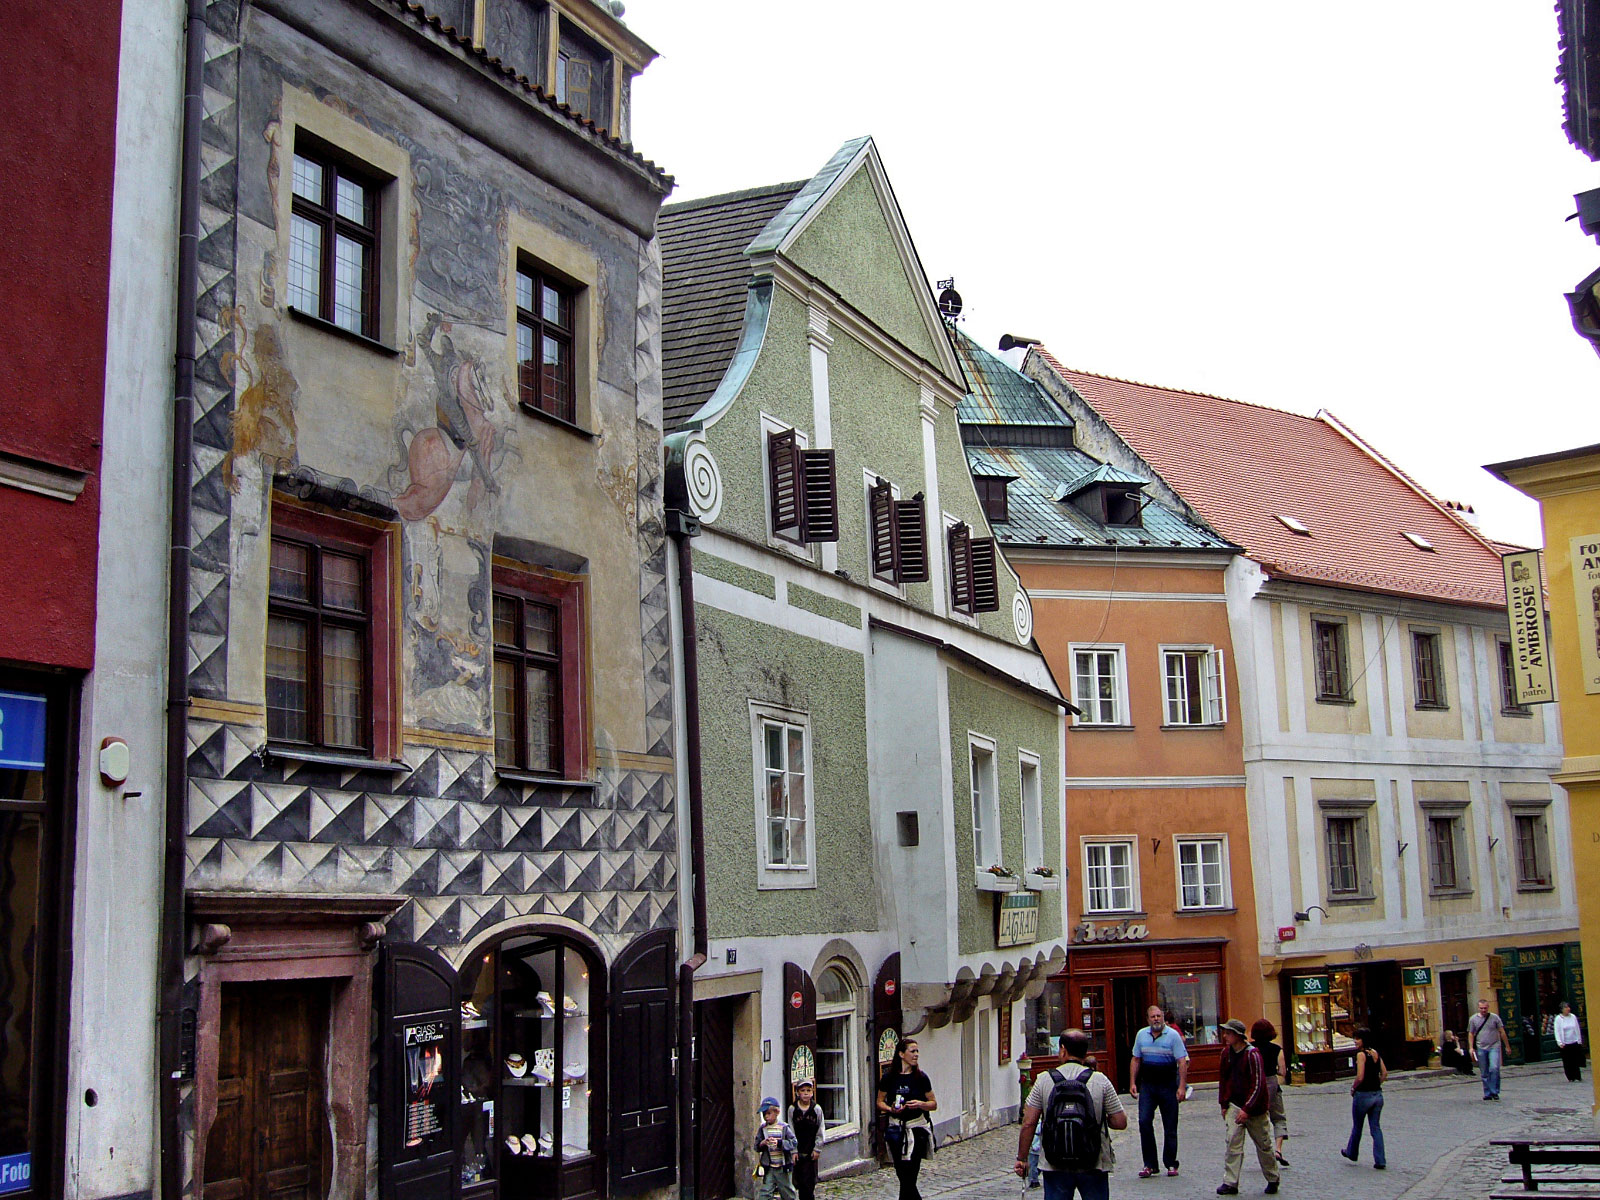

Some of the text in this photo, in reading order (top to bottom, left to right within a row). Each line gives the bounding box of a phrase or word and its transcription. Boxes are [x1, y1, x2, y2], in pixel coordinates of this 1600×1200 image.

[1580, 543, 1600, 555] FO
[1512, 586, 1529, 671] FOTOSTUDIO
[1522, 584, 1543, 668] AMBROSE
[1526, 673, 1542, 689] 1.
[1522, 687, 1547, 699] patro
[1414, 968, 1427, 980] S&A
[1303, 977, 1322, 990] S&A
